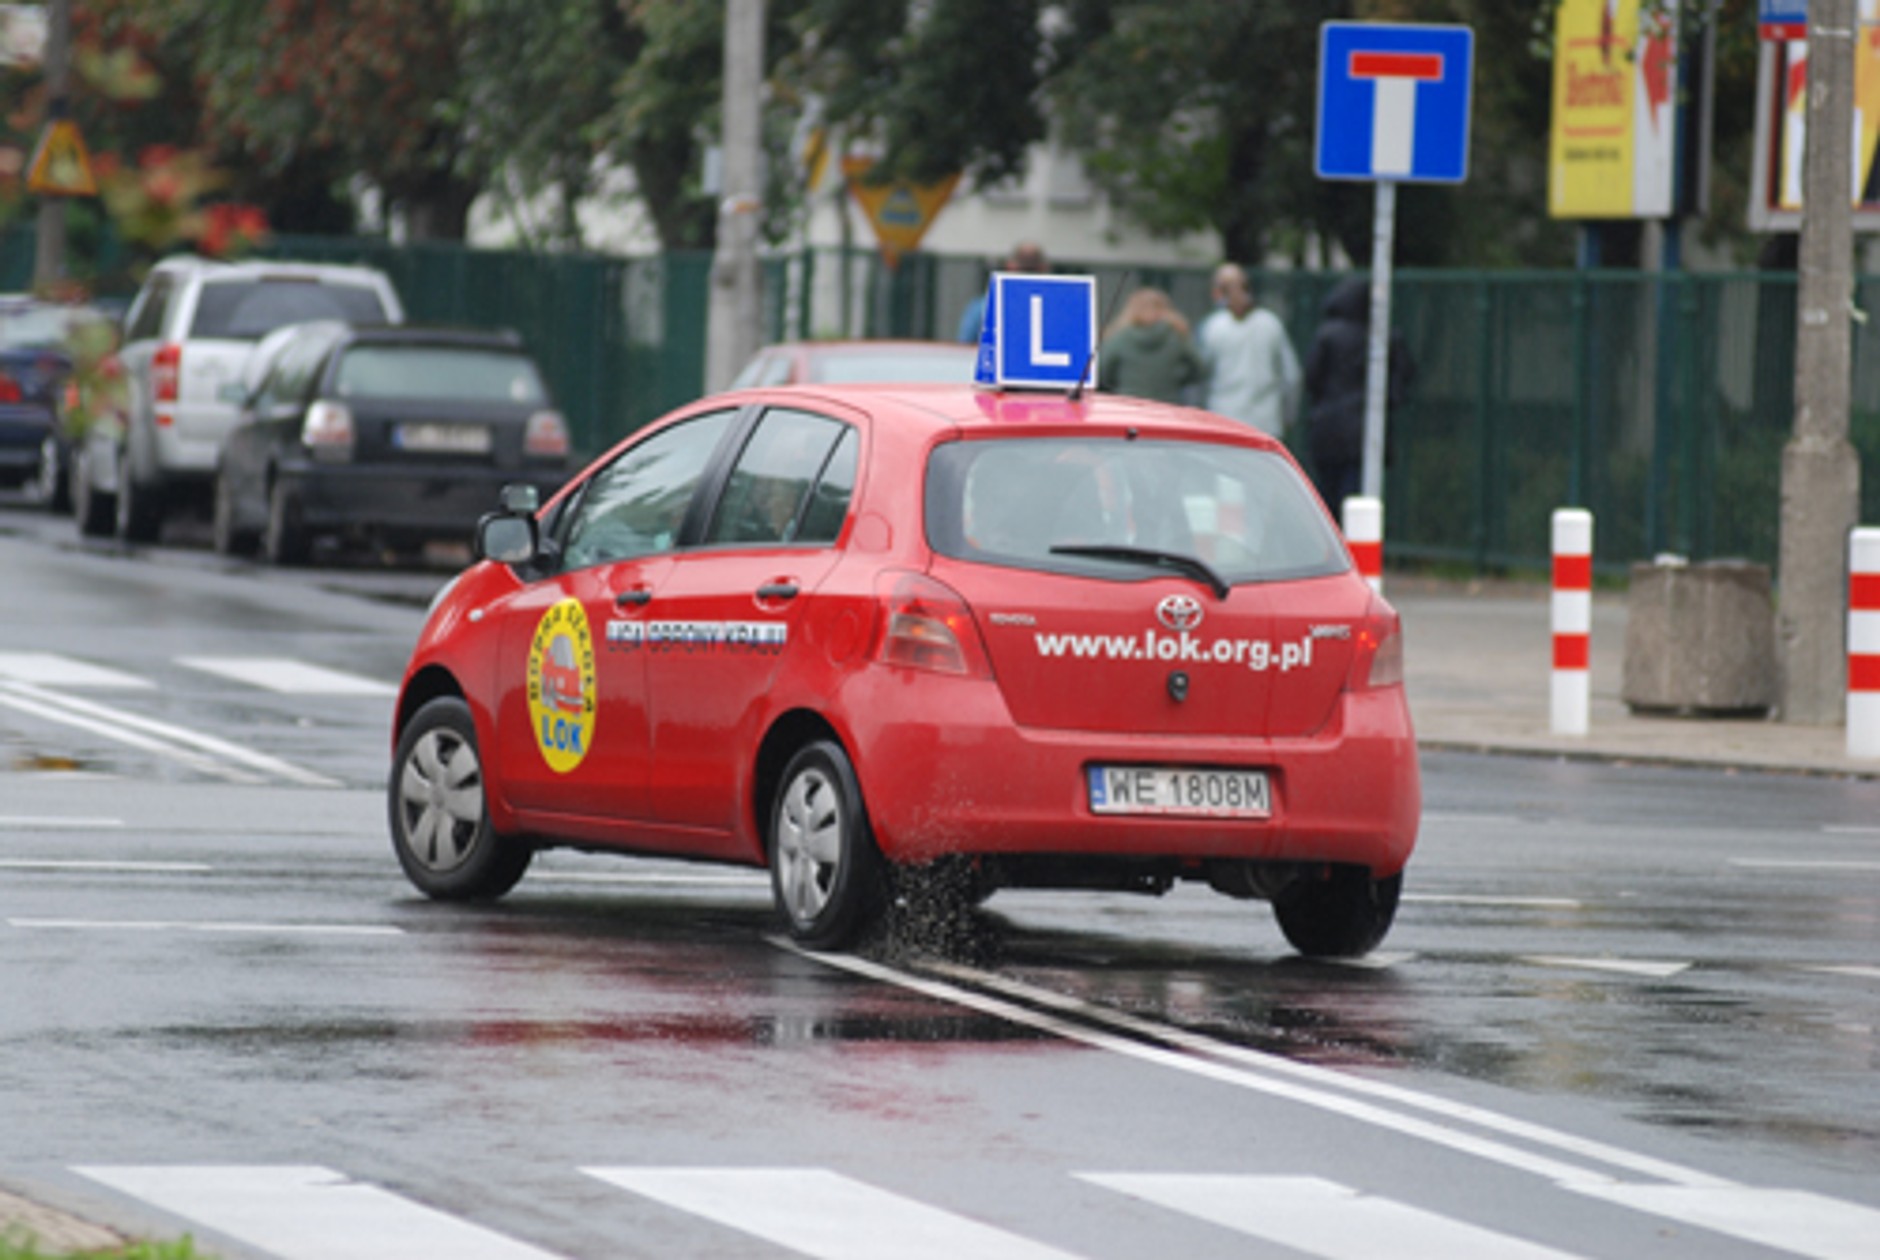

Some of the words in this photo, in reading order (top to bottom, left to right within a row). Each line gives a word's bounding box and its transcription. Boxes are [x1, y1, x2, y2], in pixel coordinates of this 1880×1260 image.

[1030, 294, 1071, 366] L
[1034, 629, 1313, 671] www.lok.org.pl
[542, 714, 585, 756] LOK
[1109, 769, 1156, 803] WE
[1169, 773, 1265, 809] 1808M
